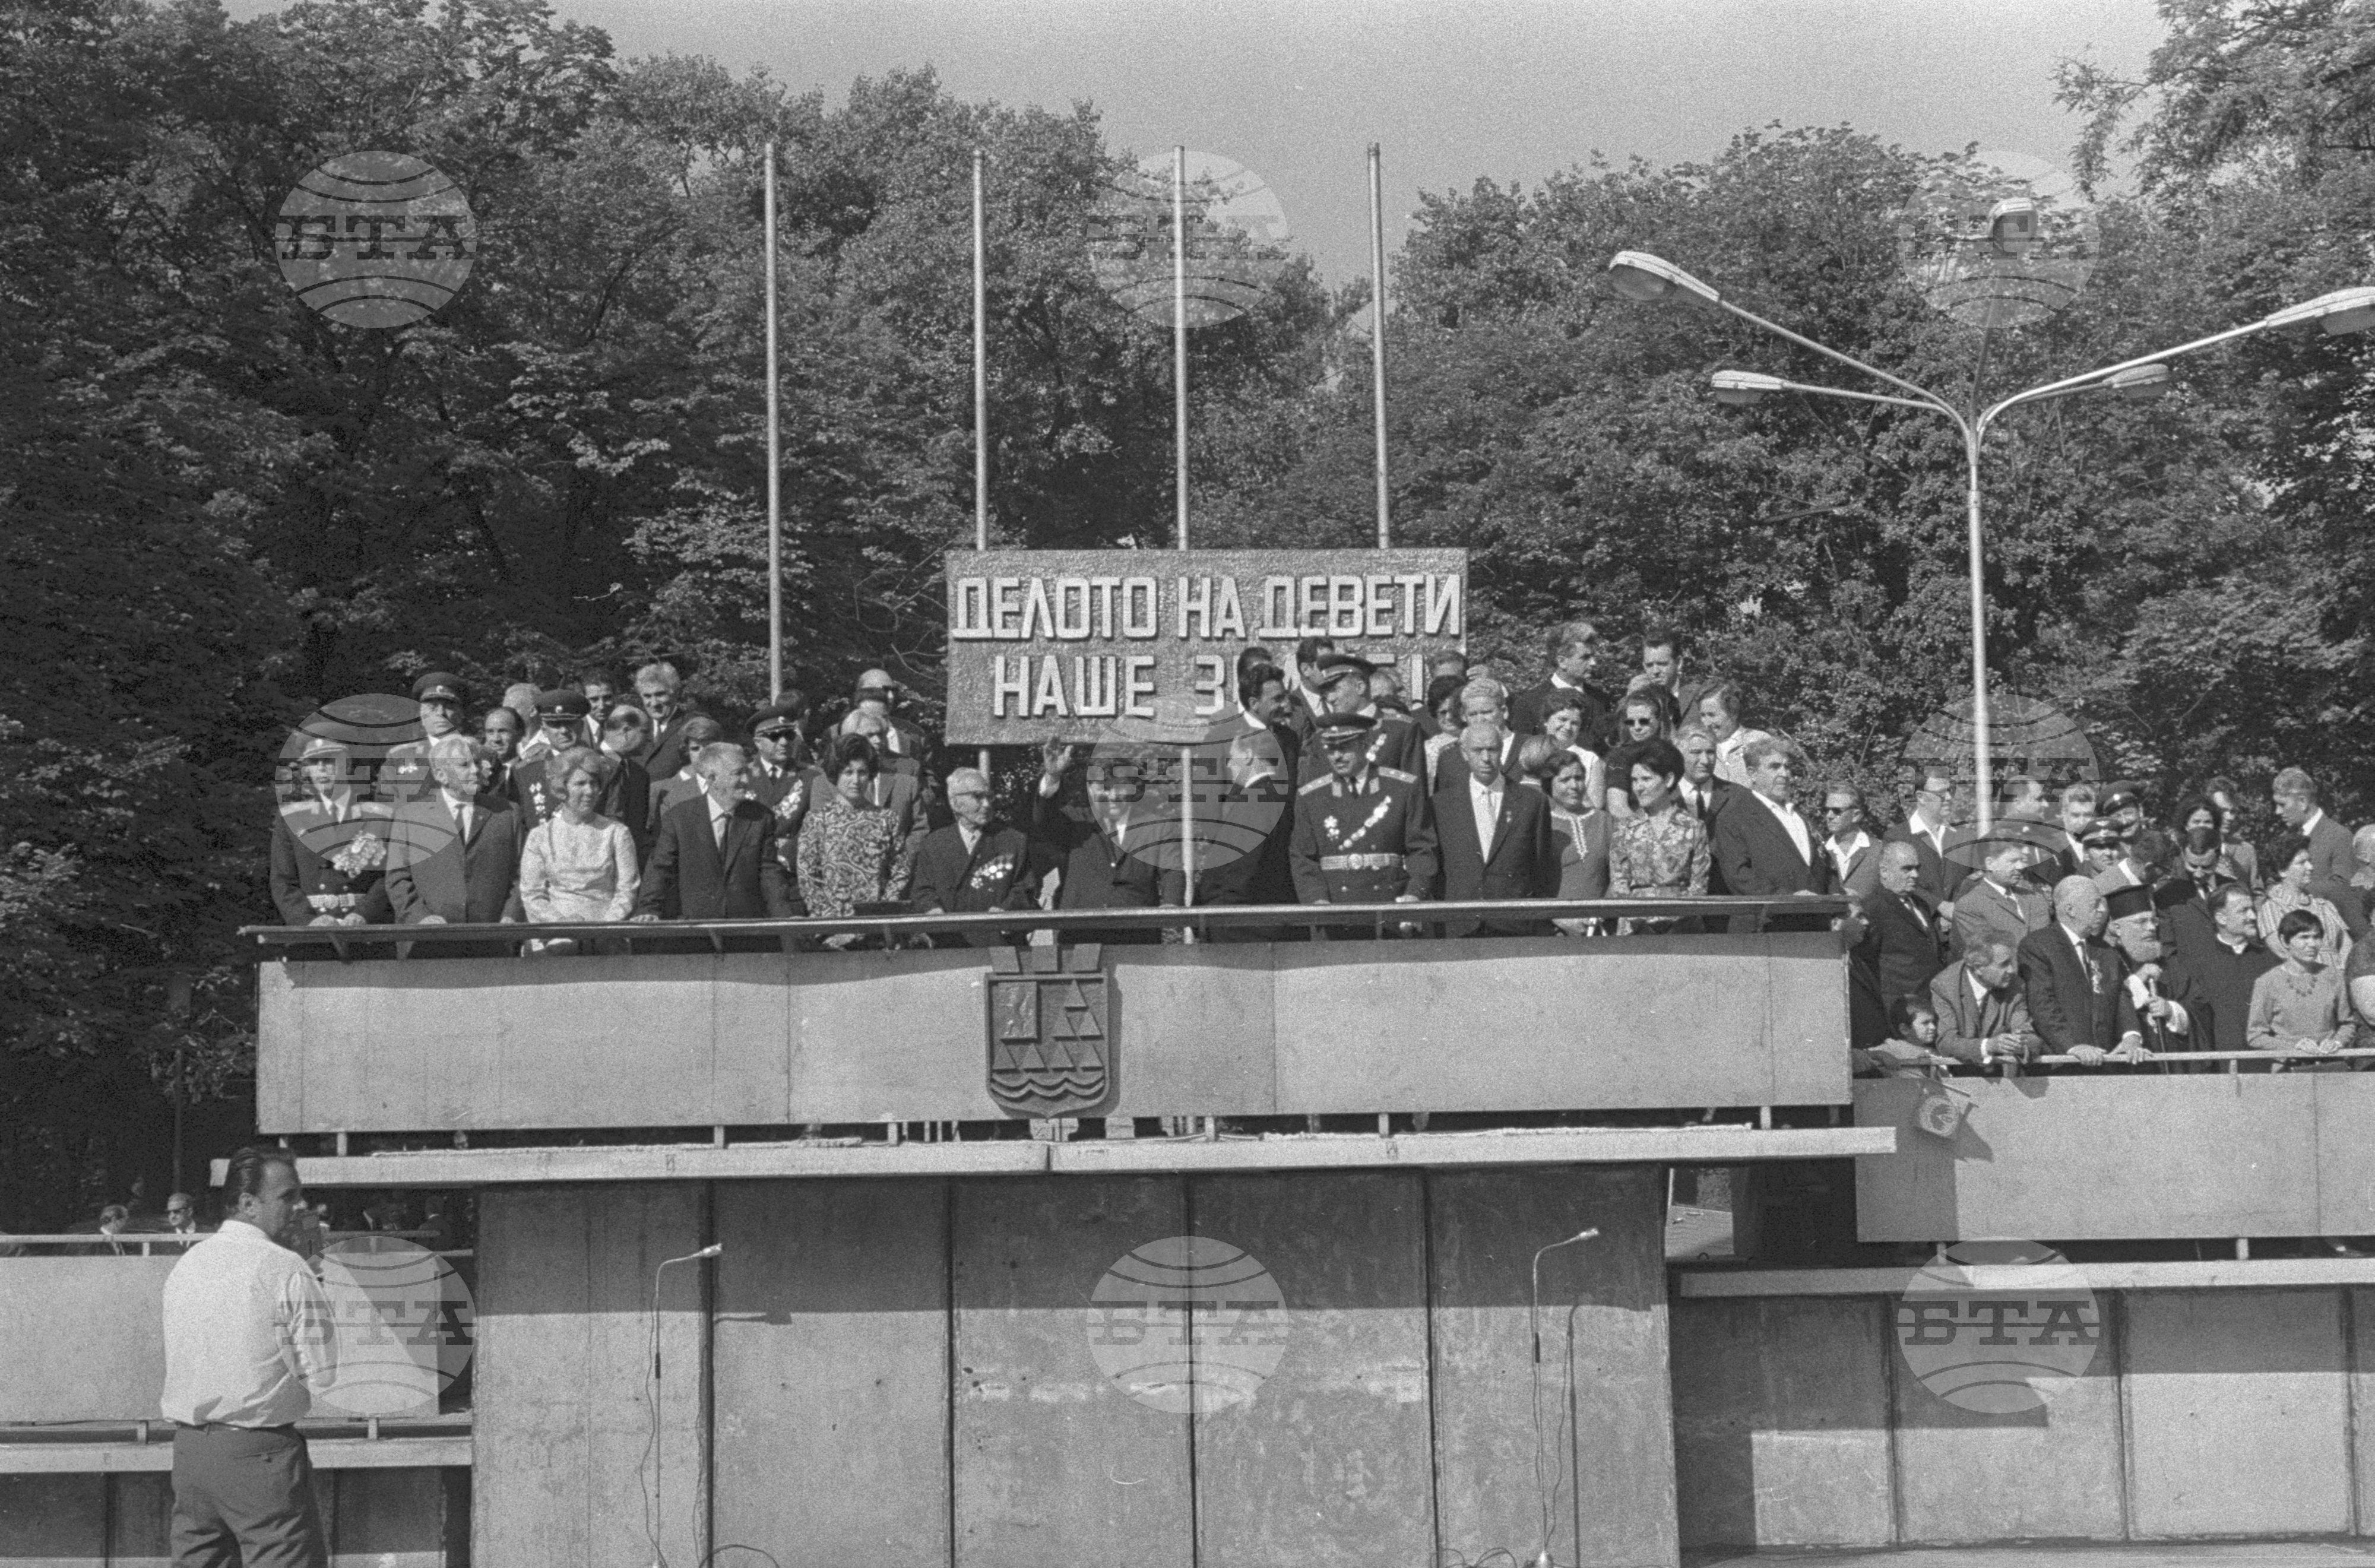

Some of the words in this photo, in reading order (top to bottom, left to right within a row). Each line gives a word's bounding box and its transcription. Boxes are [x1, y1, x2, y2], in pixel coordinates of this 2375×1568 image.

[952, 575, 1157, 639] ДЕЛОТО
[1180, 575, 1246, 638] НА
[1258, 574, 1460, 638] ДЕВЕТИ
[993, 654, 1154, 717] НАШЕ
